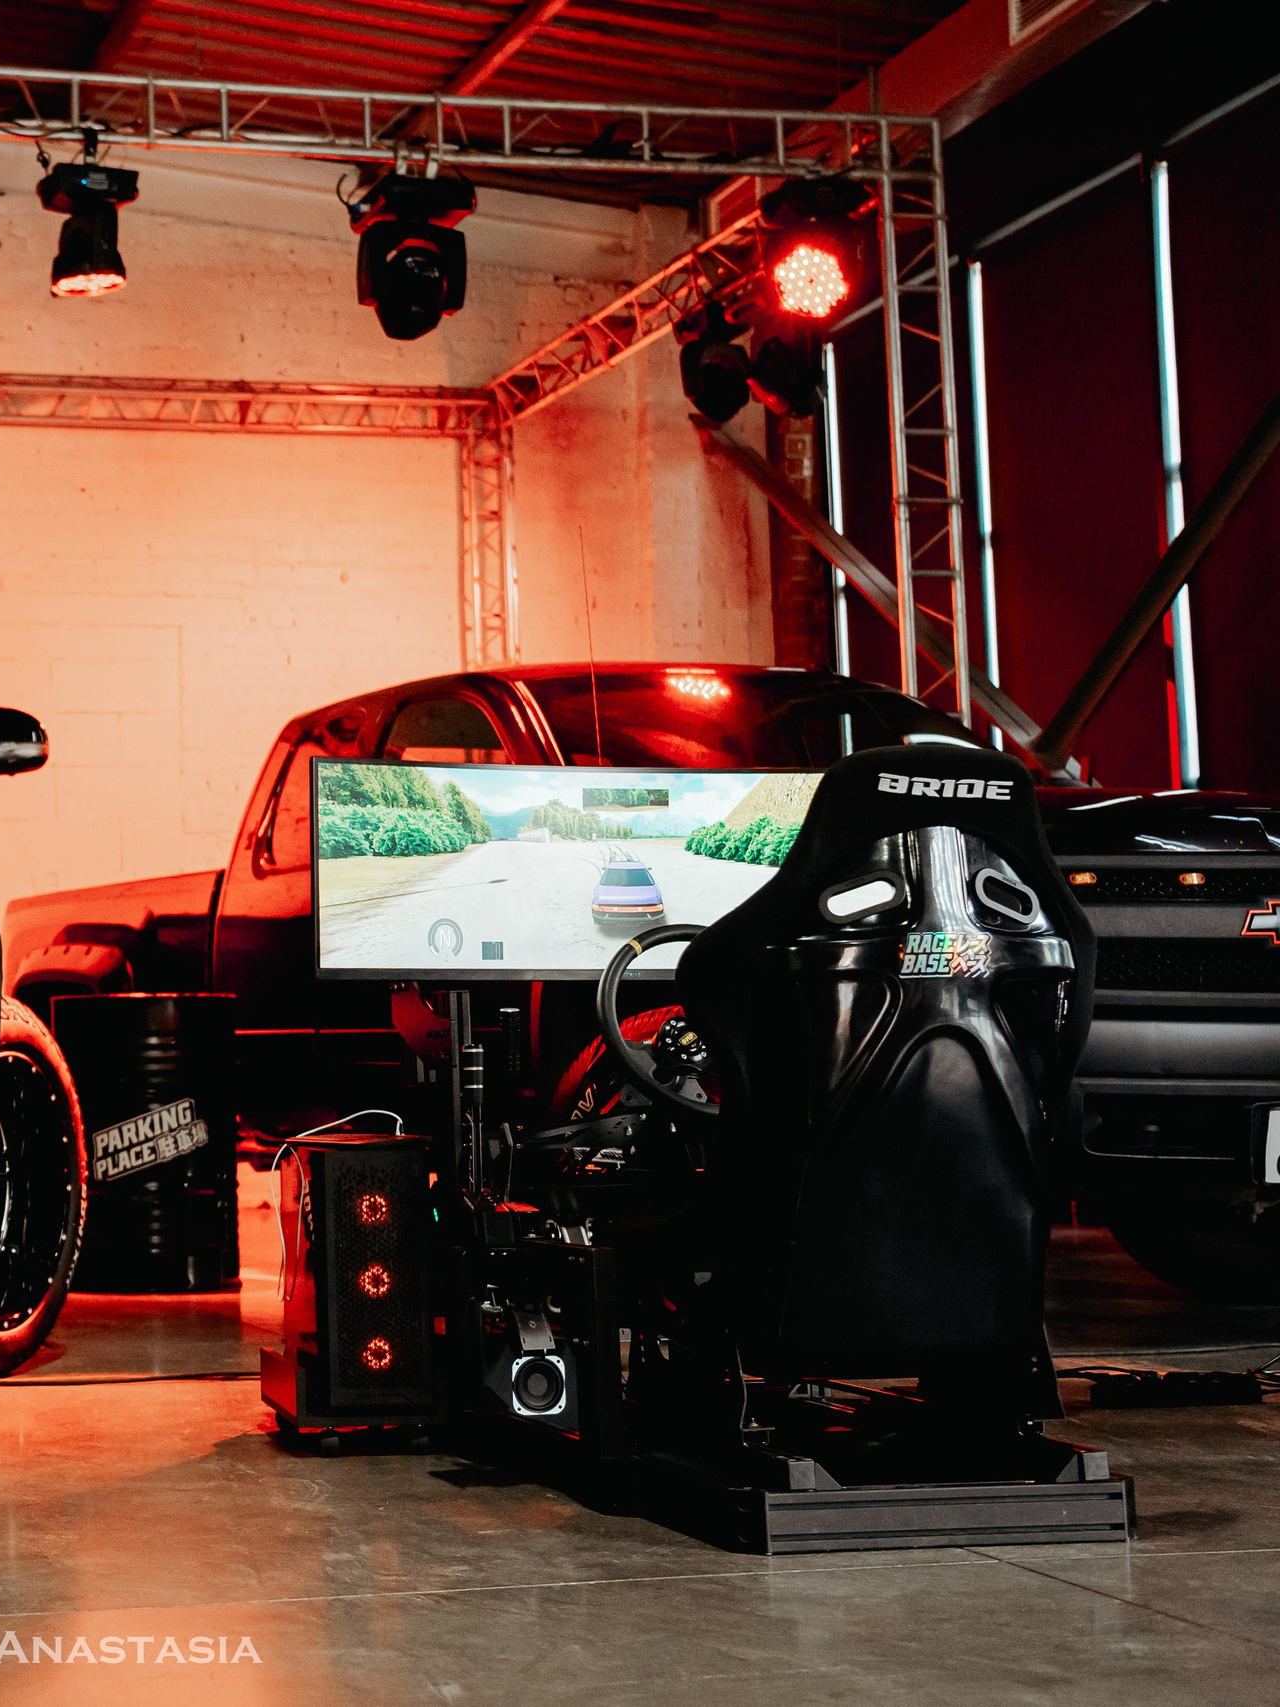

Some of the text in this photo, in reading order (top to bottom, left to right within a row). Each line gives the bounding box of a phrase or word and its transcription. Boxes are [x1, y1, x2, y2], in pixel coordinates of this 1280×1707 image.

[877, 772, 1014, 800] BRIDE
[906, 934, 957, 953] RACE
[900, 954, 953, 973] BASE
[681, 1032, 695, 1046] OMP
[95, 1101, 192, 1158] PARKING
[95, 1141, 156, 1180] PLACE
